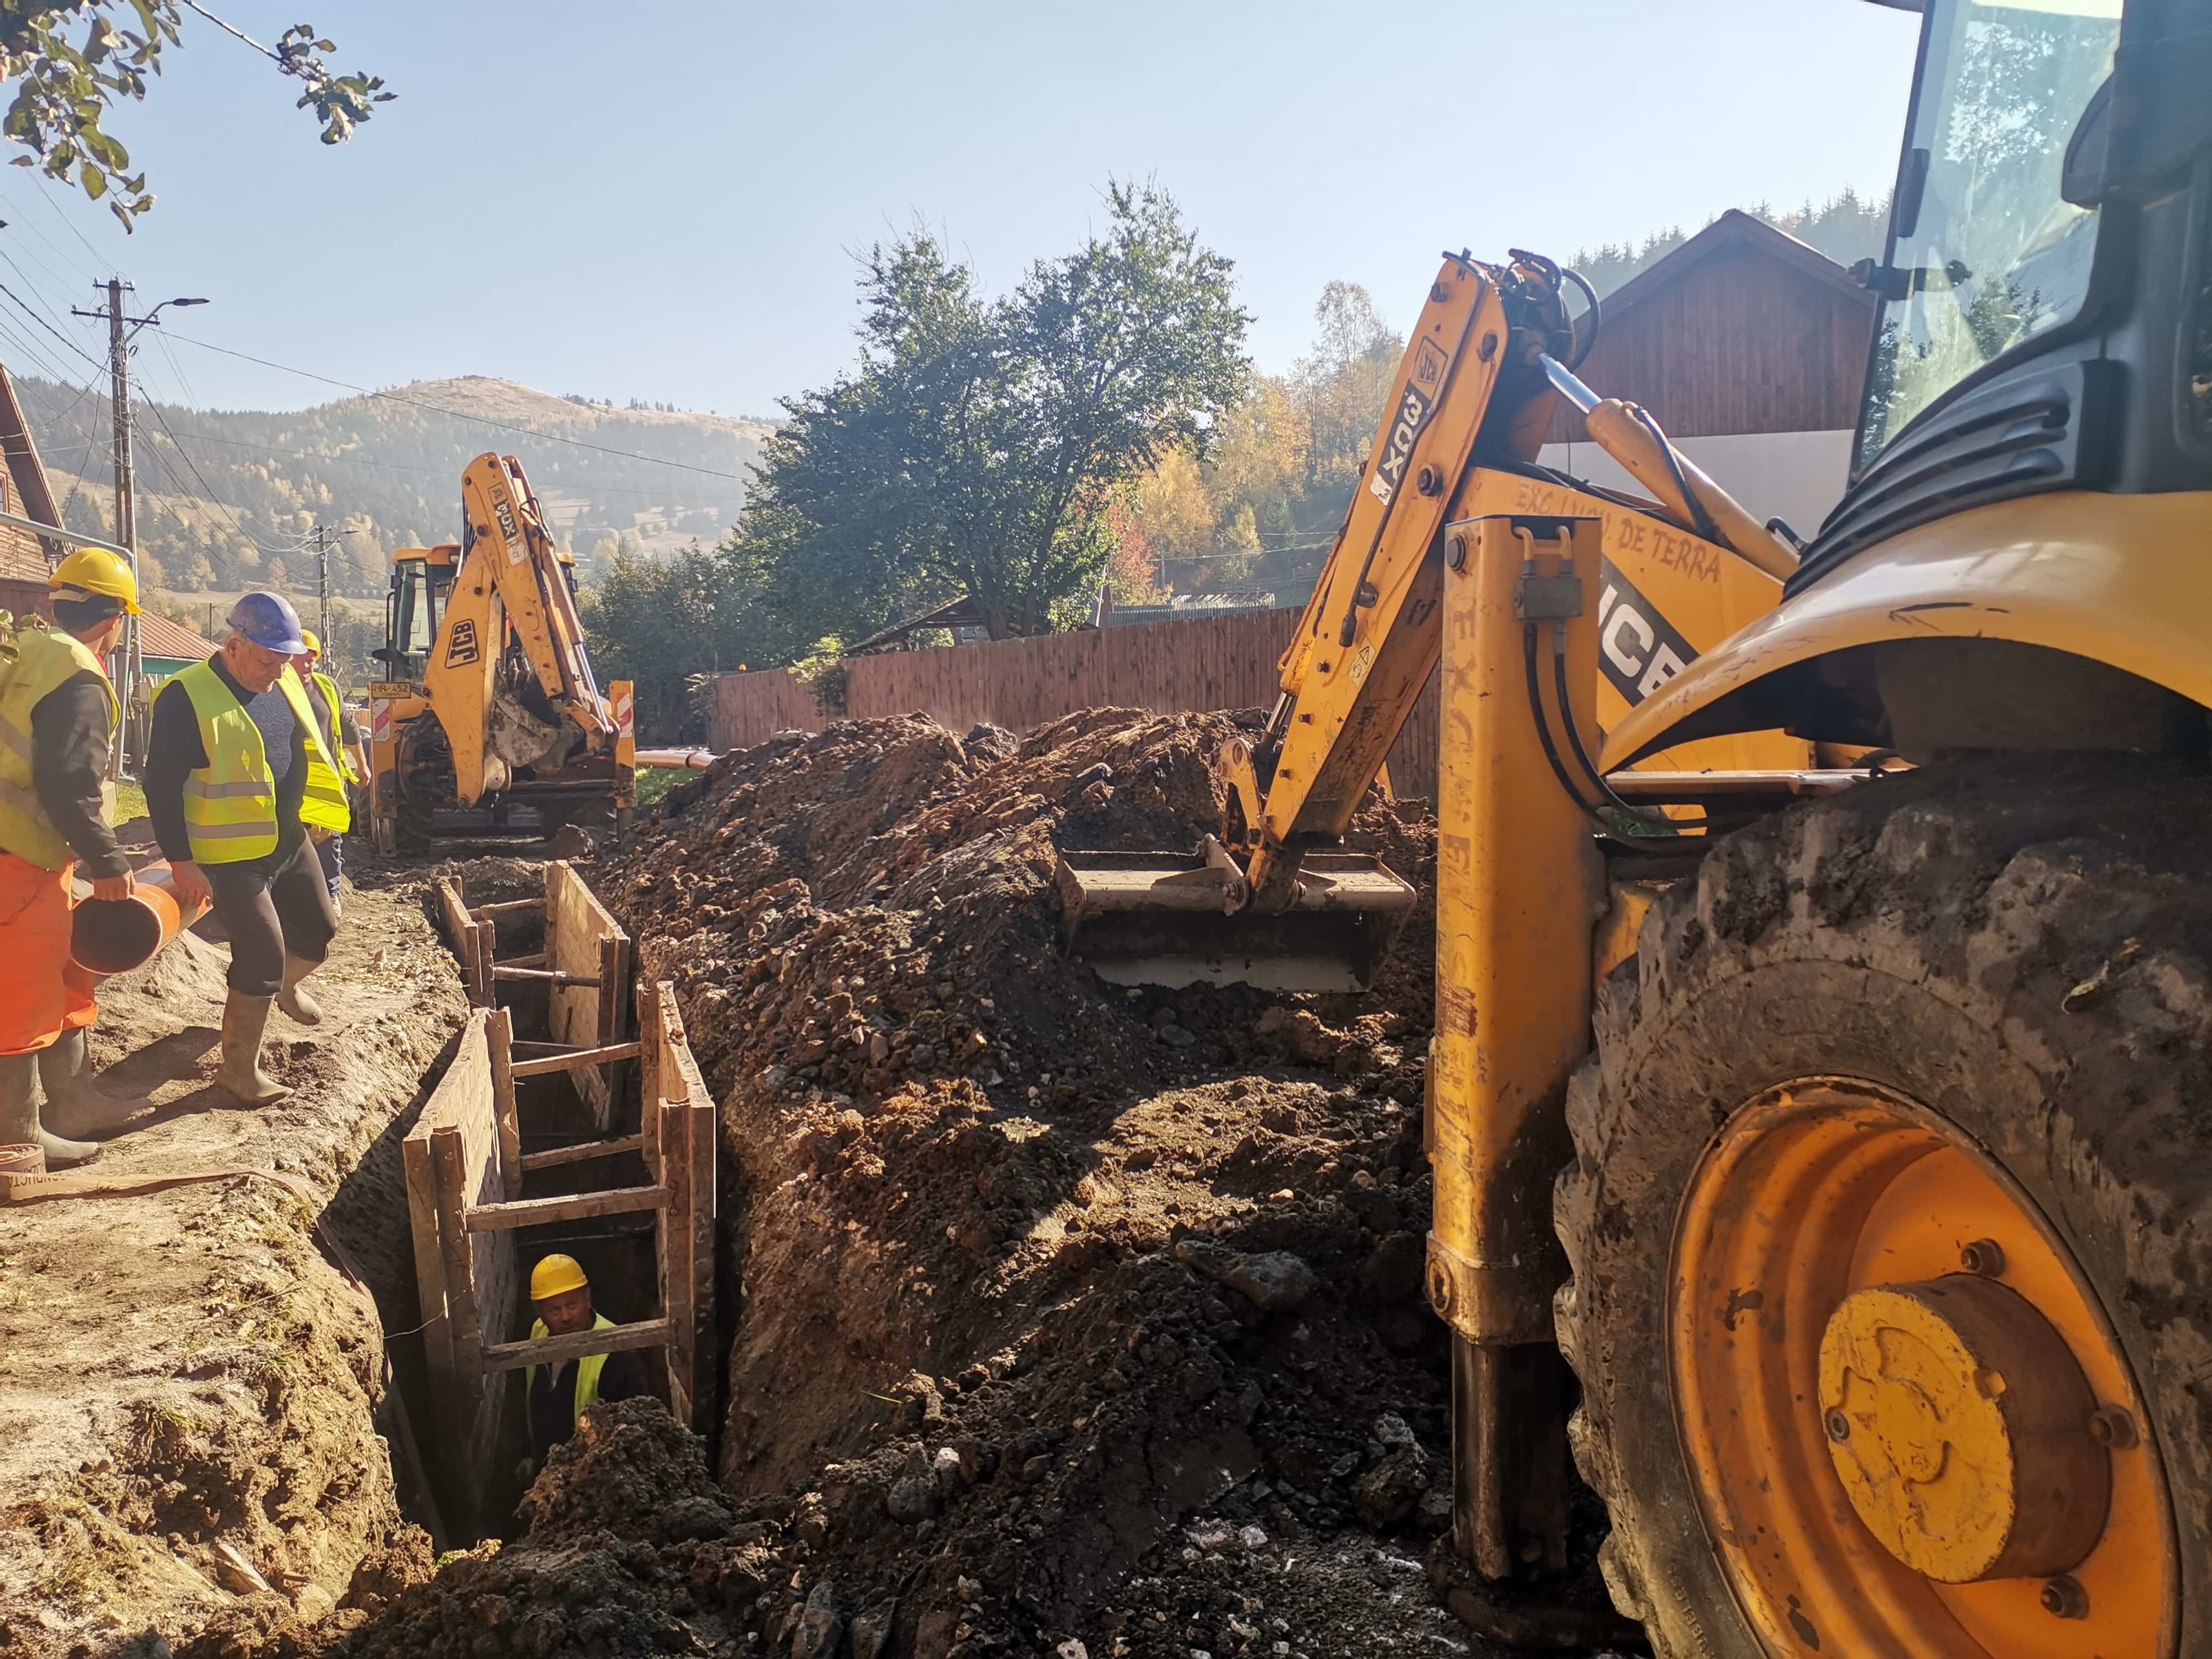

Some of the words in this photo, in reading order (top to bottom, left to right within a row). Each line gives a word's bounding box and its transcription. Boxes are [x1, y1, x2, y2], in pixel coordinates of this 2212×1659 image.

[1421, 354, 1437, 382] JCB
[1383, 393, 1423, 480] 3CX
[1618, 518, 1648, 553] DE
[1651, 529, 1721, 583] TERRA
[449, 622, 476, 660] JCB
[9, 1176, 66, 1188] DUCTA
